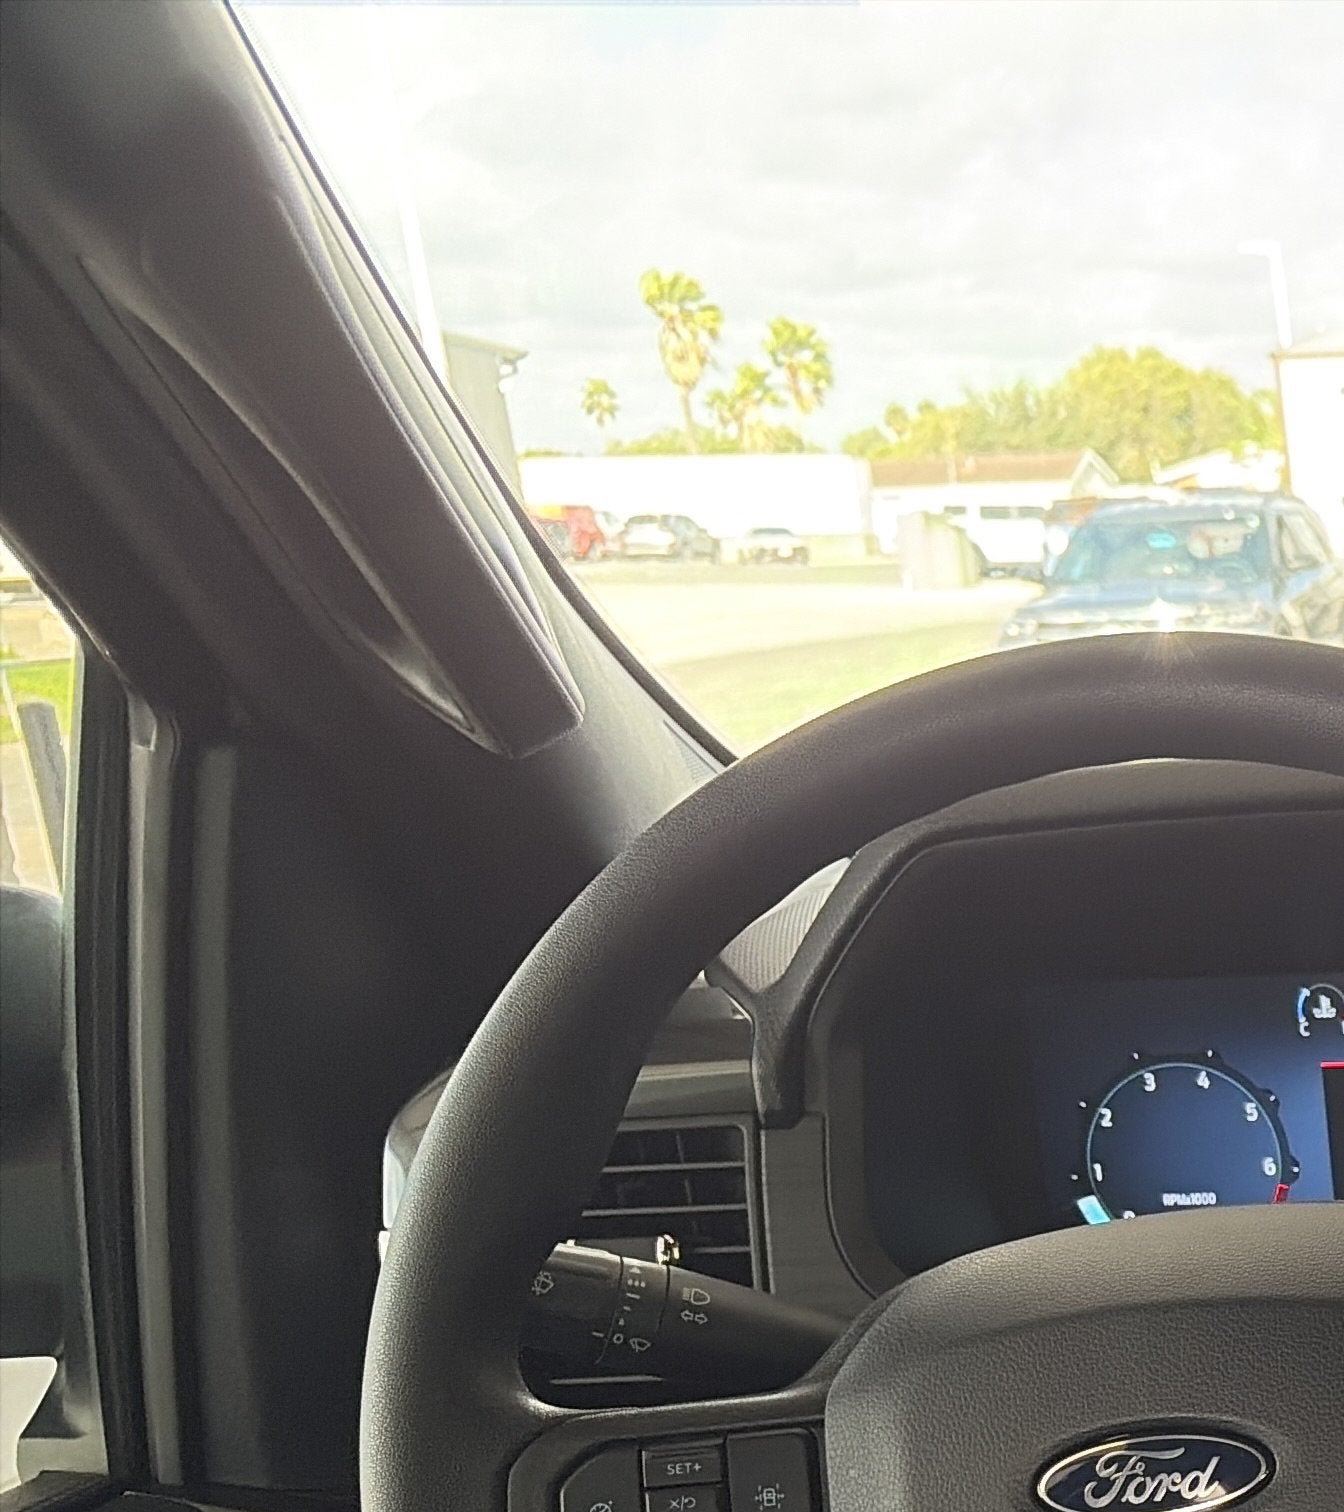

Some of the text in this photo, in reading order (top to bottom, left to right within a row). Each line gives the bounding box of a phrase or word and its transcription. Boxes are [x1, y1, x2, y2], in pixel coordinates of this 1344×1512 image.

[1299, 1021, 1310, 1037] C
[1143, 1073, 1156, 1092] 3
[1197, 1070, 1210, 1090] 4
[1100, 1108, 1113, 1127] 2
[1245, 1102, 1259, 1122] 5
[1093, 1163, 1103, 1182] 1
[1262, 1157, 1276, 1176] 6
[666, 1462, 703, 1476] SET+
[1084, 1446, 1222, 1509] Ford
